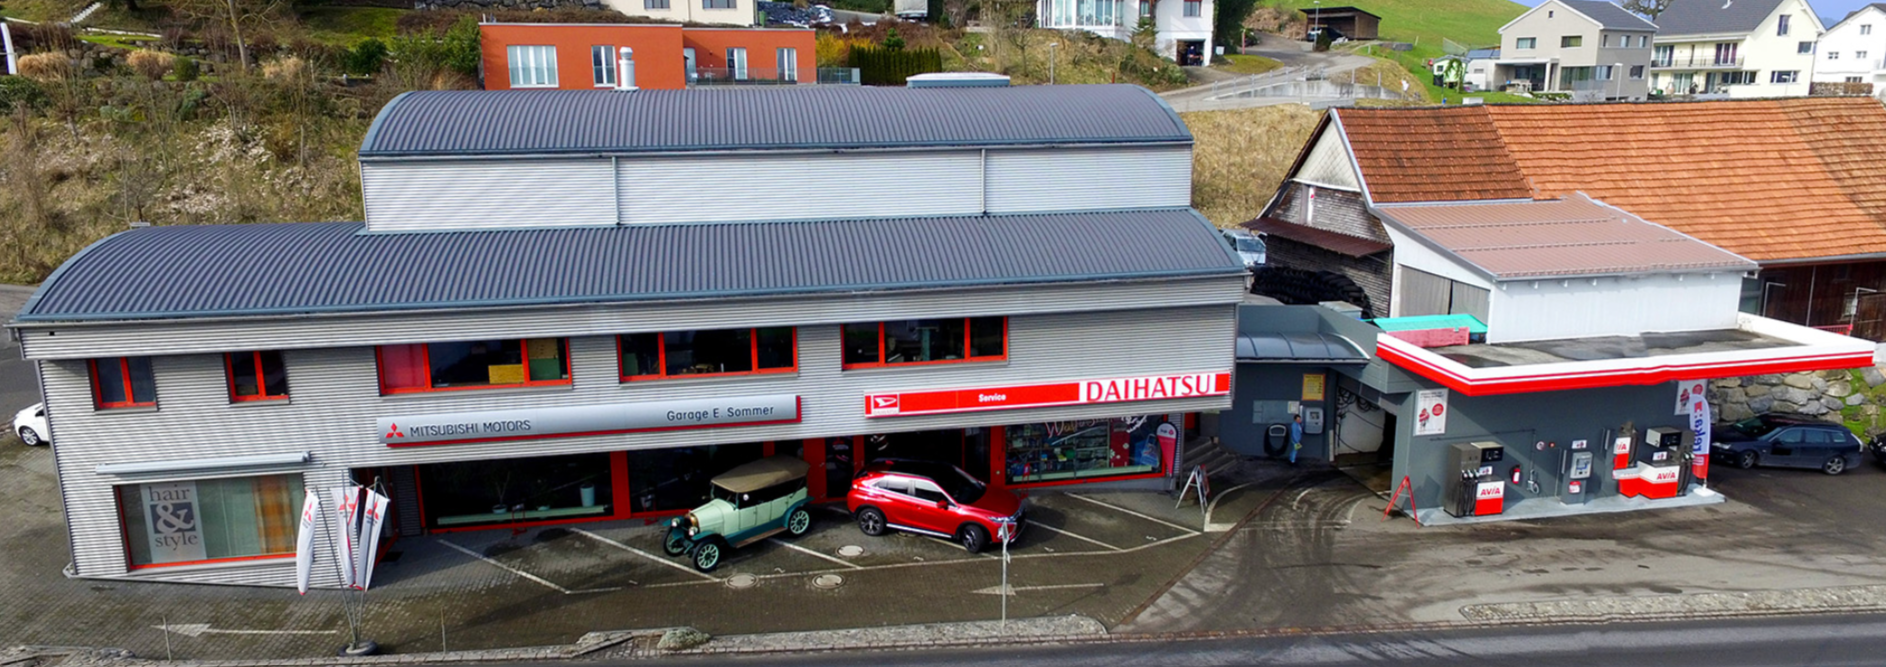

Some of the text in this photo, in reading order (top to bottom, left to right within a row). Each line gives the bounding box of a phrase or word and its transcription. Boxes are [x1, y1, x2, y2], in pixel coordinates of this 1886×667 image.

[978, 392, 1007, 403] Service
[1086, 375, 1210, 402] DAIHATSU
[666, 406, 774, 422] Garage E. Sommer
[410, 419, 532, 438] MITSUBISHI MOTORS
[1656, 472, 1676, 480] AVIA
[148, 484, 191, 502] hair
[1480, 487, 1501, 496] AVIA
[155, 501, 195, 534] &
[155, 531, 198, 551] style
